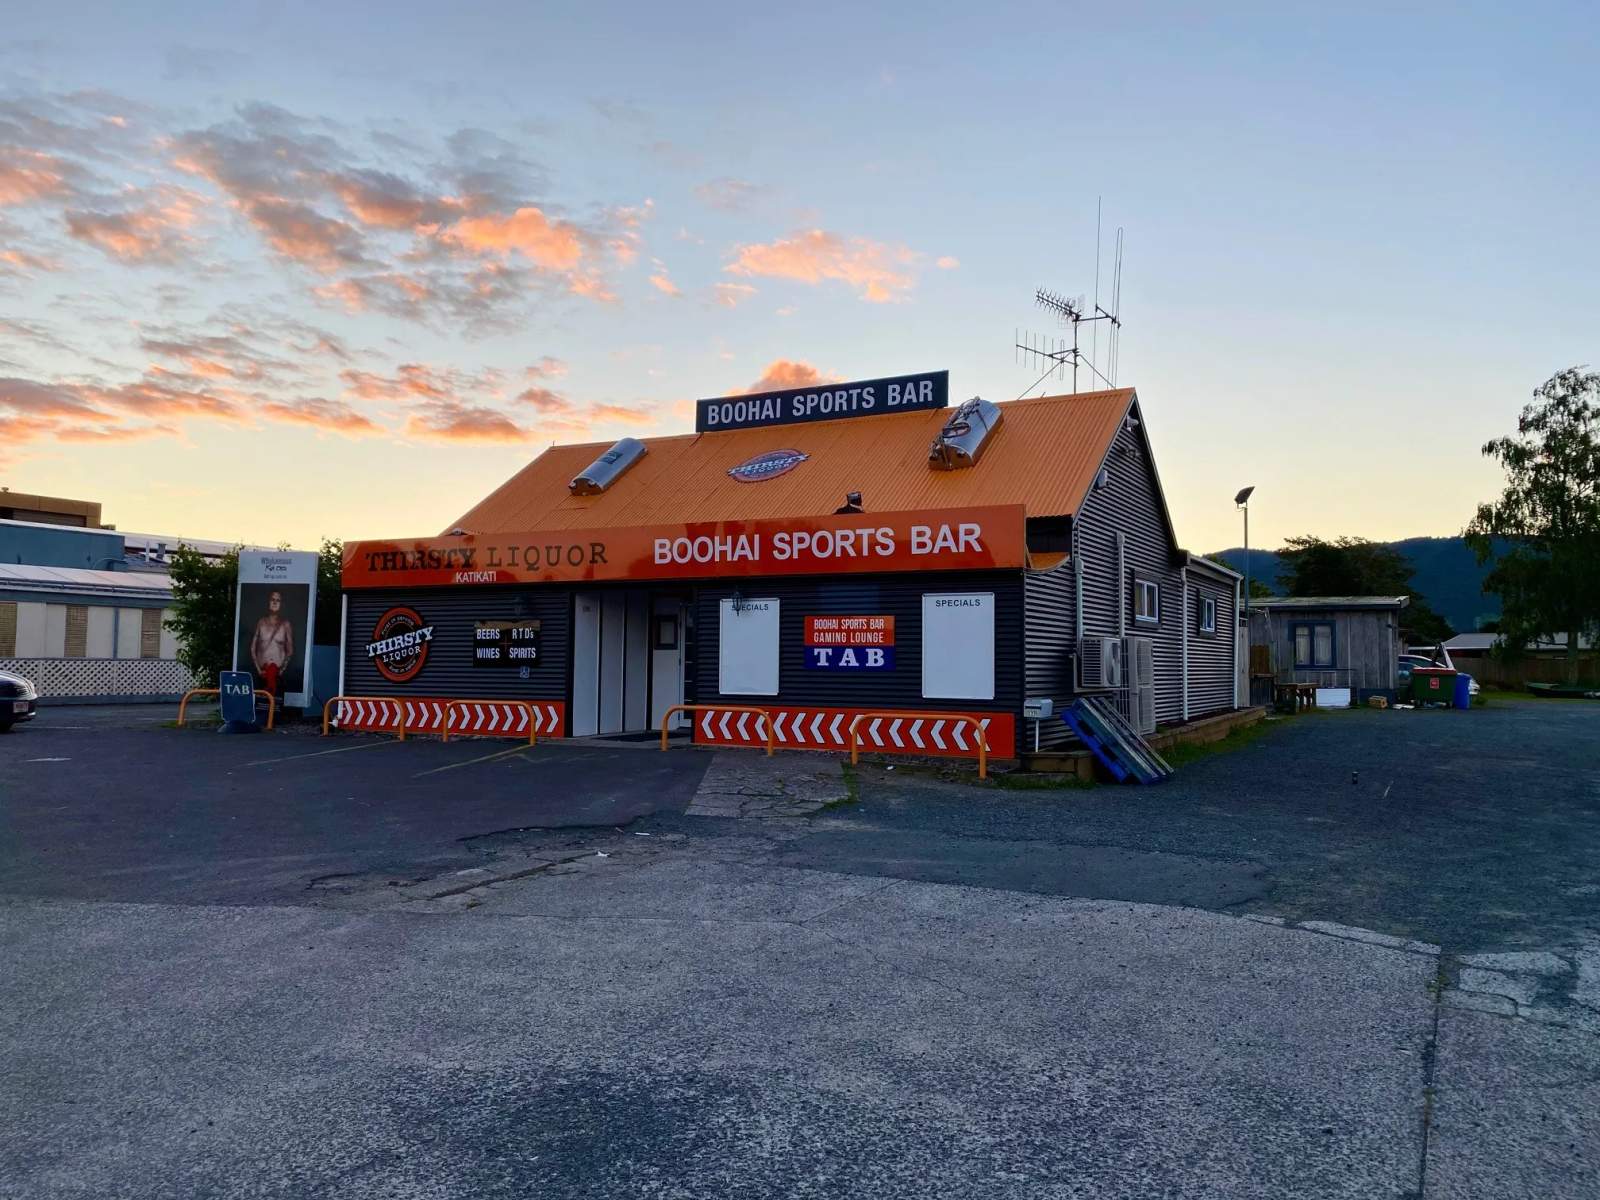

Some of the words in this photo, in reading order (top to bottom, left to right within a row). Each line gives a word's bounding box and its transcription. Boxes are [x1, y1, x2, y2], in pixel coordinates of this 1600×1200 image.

[707, 398, 781, 425] BOOHAI
[792, 386, 876, 415] SPORTS
[887, 380, 933, 406] BAR
[654, 534, 759, 564] BOOHAI
[772, 526, 895, 560] SPORTS
[911, 522, 982, 555] BAR
[366, 548, 476, 572] THIRSTY
[486, 543, 608, 569] LIQUOR
[455, 571, 497, 583] KATIKATI
[935, 598, 981, 607] SPECIALS
[813, 618, 838, 630] BOOHAI
[840, 618, 867, 629] SPORTS
[869, 618, 885, 629] BAR
[476, 628, 500, 640] BEERS
[813, 632, 847, 643] GAMING
[850, 632, 884, 643] LOUNGE
[366, 626, 434, 657] THIRSTY
[383, 646, 421, 663] LIQUOR
[476, 648, 500, 659] WINES
[509, 647, 536, 659] SPIRITS
[224, 684, 250, 696] TAB
